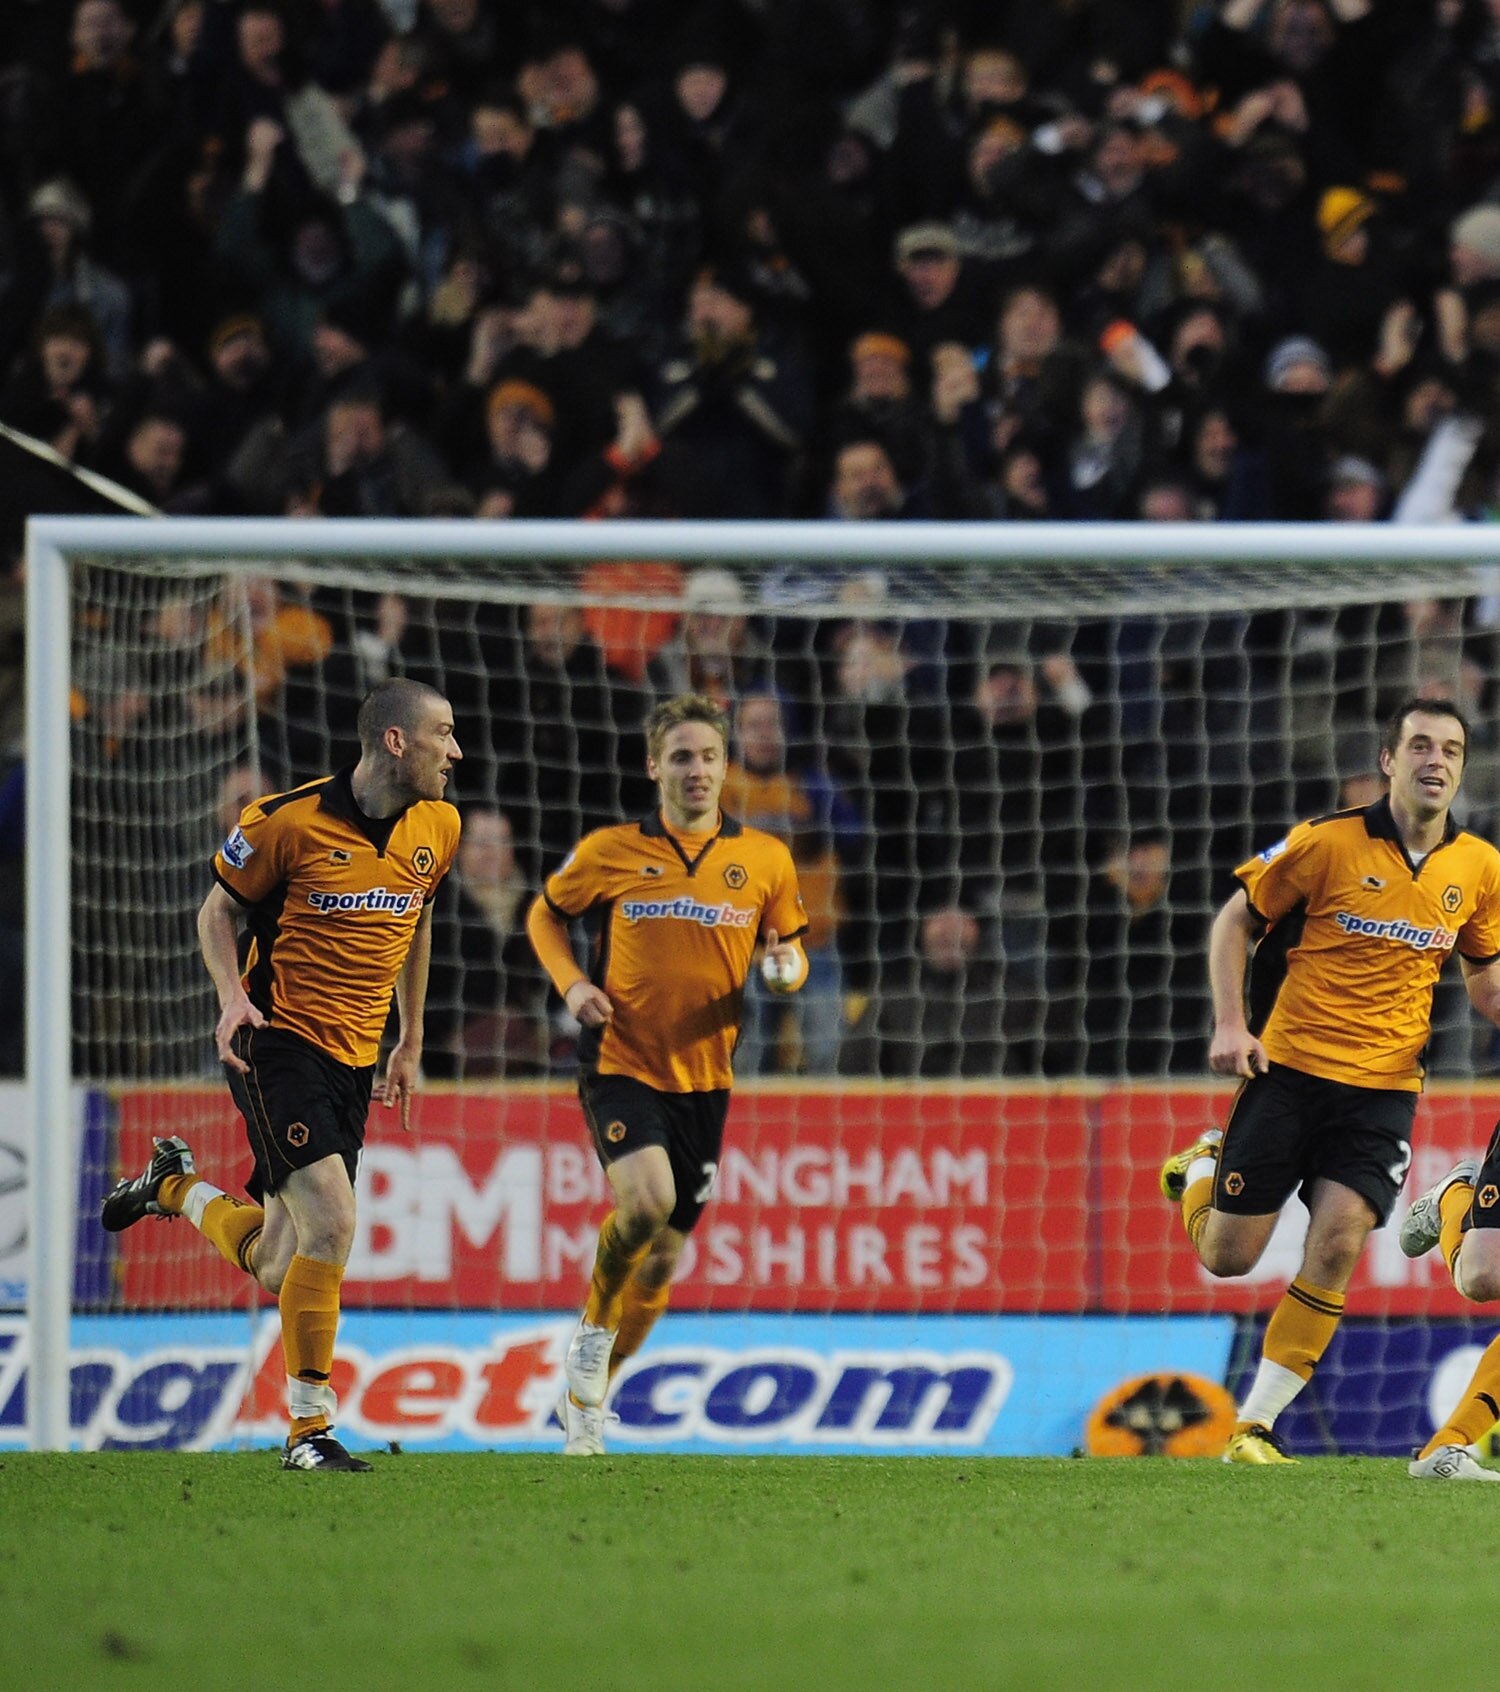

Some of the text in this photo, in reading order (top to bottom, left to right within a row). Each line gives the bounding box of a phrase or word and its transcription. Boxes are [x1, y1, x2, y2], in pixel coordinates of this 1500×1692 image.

[622, 896, 756, 927] sportingbet
[548, 1145, 988, 1207] BINGHAM
[340, 1143, 542, 1283] BM
[548, 1222, 990, 1287] MSHIRES
[0, 1328, 992, 1450] ngbet.com
